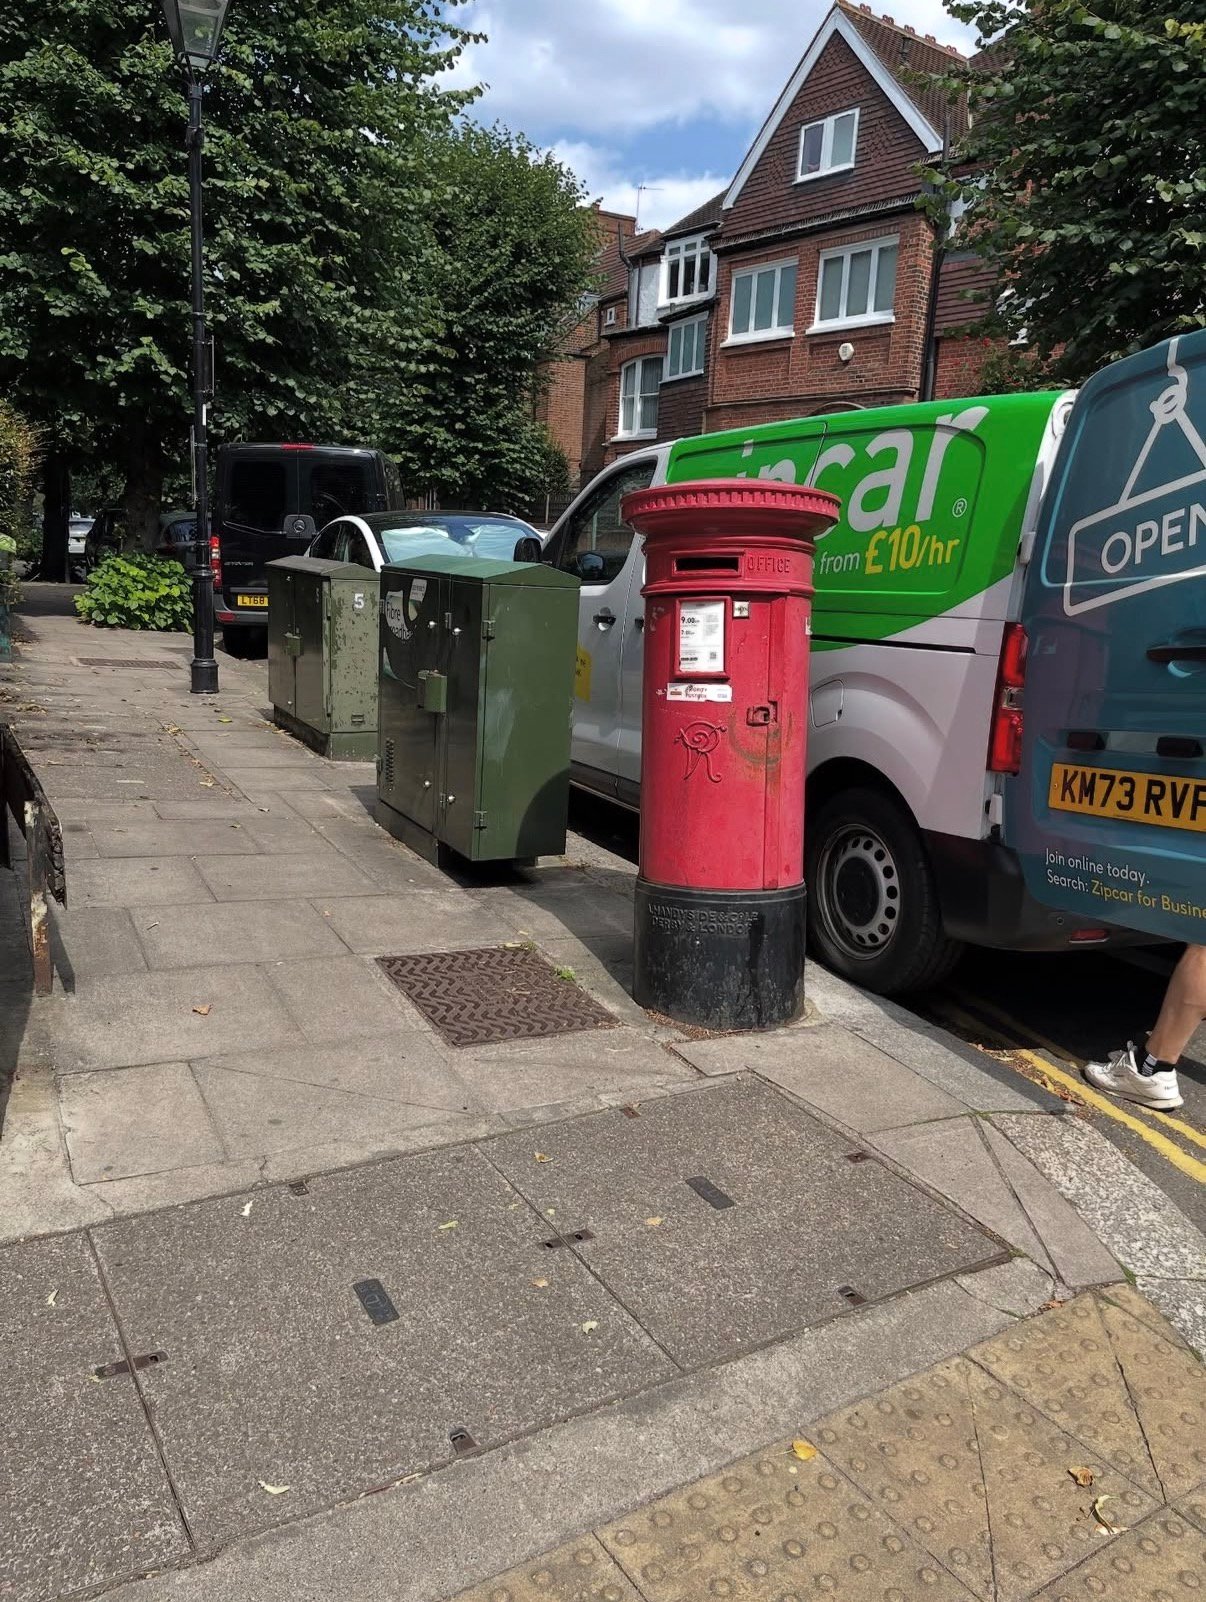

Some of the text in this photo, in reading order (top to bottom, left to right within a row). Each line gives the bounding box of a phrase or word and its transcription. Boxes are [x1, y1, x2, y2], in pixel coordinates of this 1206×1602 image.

[736, 405, 989, 541] car
[746, 557, 791, 574] OFFICE
[819, 551, 860, 575] from
[864, 524, 961, 575] £10/hr
[241, 595, 265, 605] LT68
[354, 593, 364, 609] 5
[386, 601, 401, 621] Fibre
[1060, 769, 1136, 811] KM73
[1045, 847, 1150, 887] Join online today.
[1047, 870, 1089, 893] Search:
[1091, 879, 1134, 902] Zipcar
[1137, 891, 1157, 908] for
